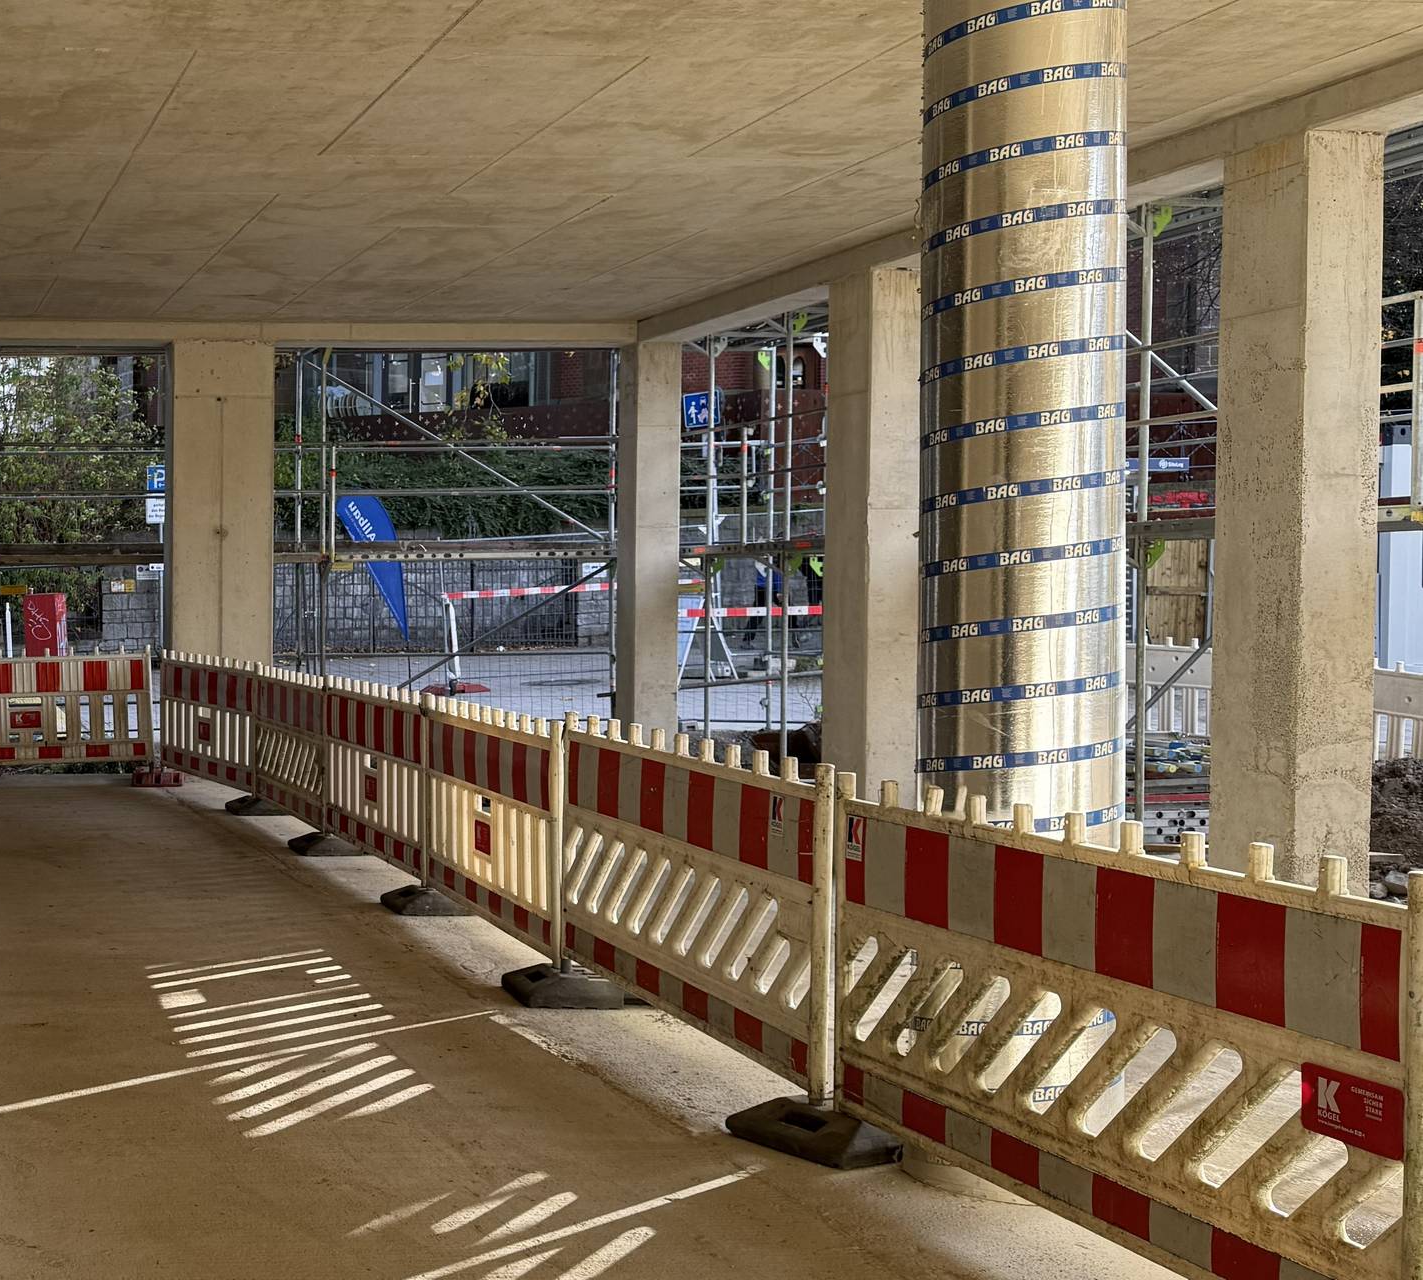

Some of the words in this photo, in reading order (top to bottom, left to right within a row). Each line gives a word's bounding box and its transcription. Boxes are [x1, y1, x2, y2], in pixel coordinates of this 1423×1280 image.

[967, 14, 995, 33] BAG
[1030, 0, 1061, 15] BAG
[933, 98, 950, 116] BAG
[978, 79, 1008, 97] BAG
[1043, 66, 1073, 82] BAG
[1101, 63, 1119, 75] BAG
[939, 161, 959, 179] BAG
[990, 144, 1021, 161] BAG
[1056, 135, 1084, 149] BAG
[945, 224, 970, 242] BAG
[1002, 210, 1034, 227] BAG
[1068, 201, 1093, 216] BAG
[954, 289, 981, 305] BAG
[1014, 277, 1046, 293] BAG
[1079, 270, 1103, 283] BAG
[925, 367, 940, 383] BAG
[964, 353, 993, 369] BAG
[1028, 343, 1058, 358] BAG
[1089, 337, 1109, 350] BAG
[929, 430, 948, 445] BAG
[976, 419, 1005, 434] BAG
[1041, 410, 1070, 424] BAG
[1098, 405, 1115, 418] BAG
[935, 494, 956, 508] BAG
[987, 484, 1018, 499] BAG
[1053, 477, 1081, 491] BAG
[1106, 471, 1120, 484] BAG
[943, 559, 966, 573] BAG
[1000, 550, 1031, 565] BAG
[1065, 543, 1090, 557] BAG
[952, 624, 978, 638] BAG
[1013, 616, 1043, 631] BAG
[1076, 609, 1099, 623] BAG
[922, 695, 936, 706] BAG
[961, 690, 991, 703] BAG
[1025, 683, 1056, 696] BAG
[1085, 676, 1106, 690] BAG
[926, 759, 945, 770] BAG
[973, 755, 1003, 768] BAG
[1038, 750, 1067, 764] BAG
[1095, 742, 1113, 755] BAG
[1103, 807, 1117, 820] BAG
